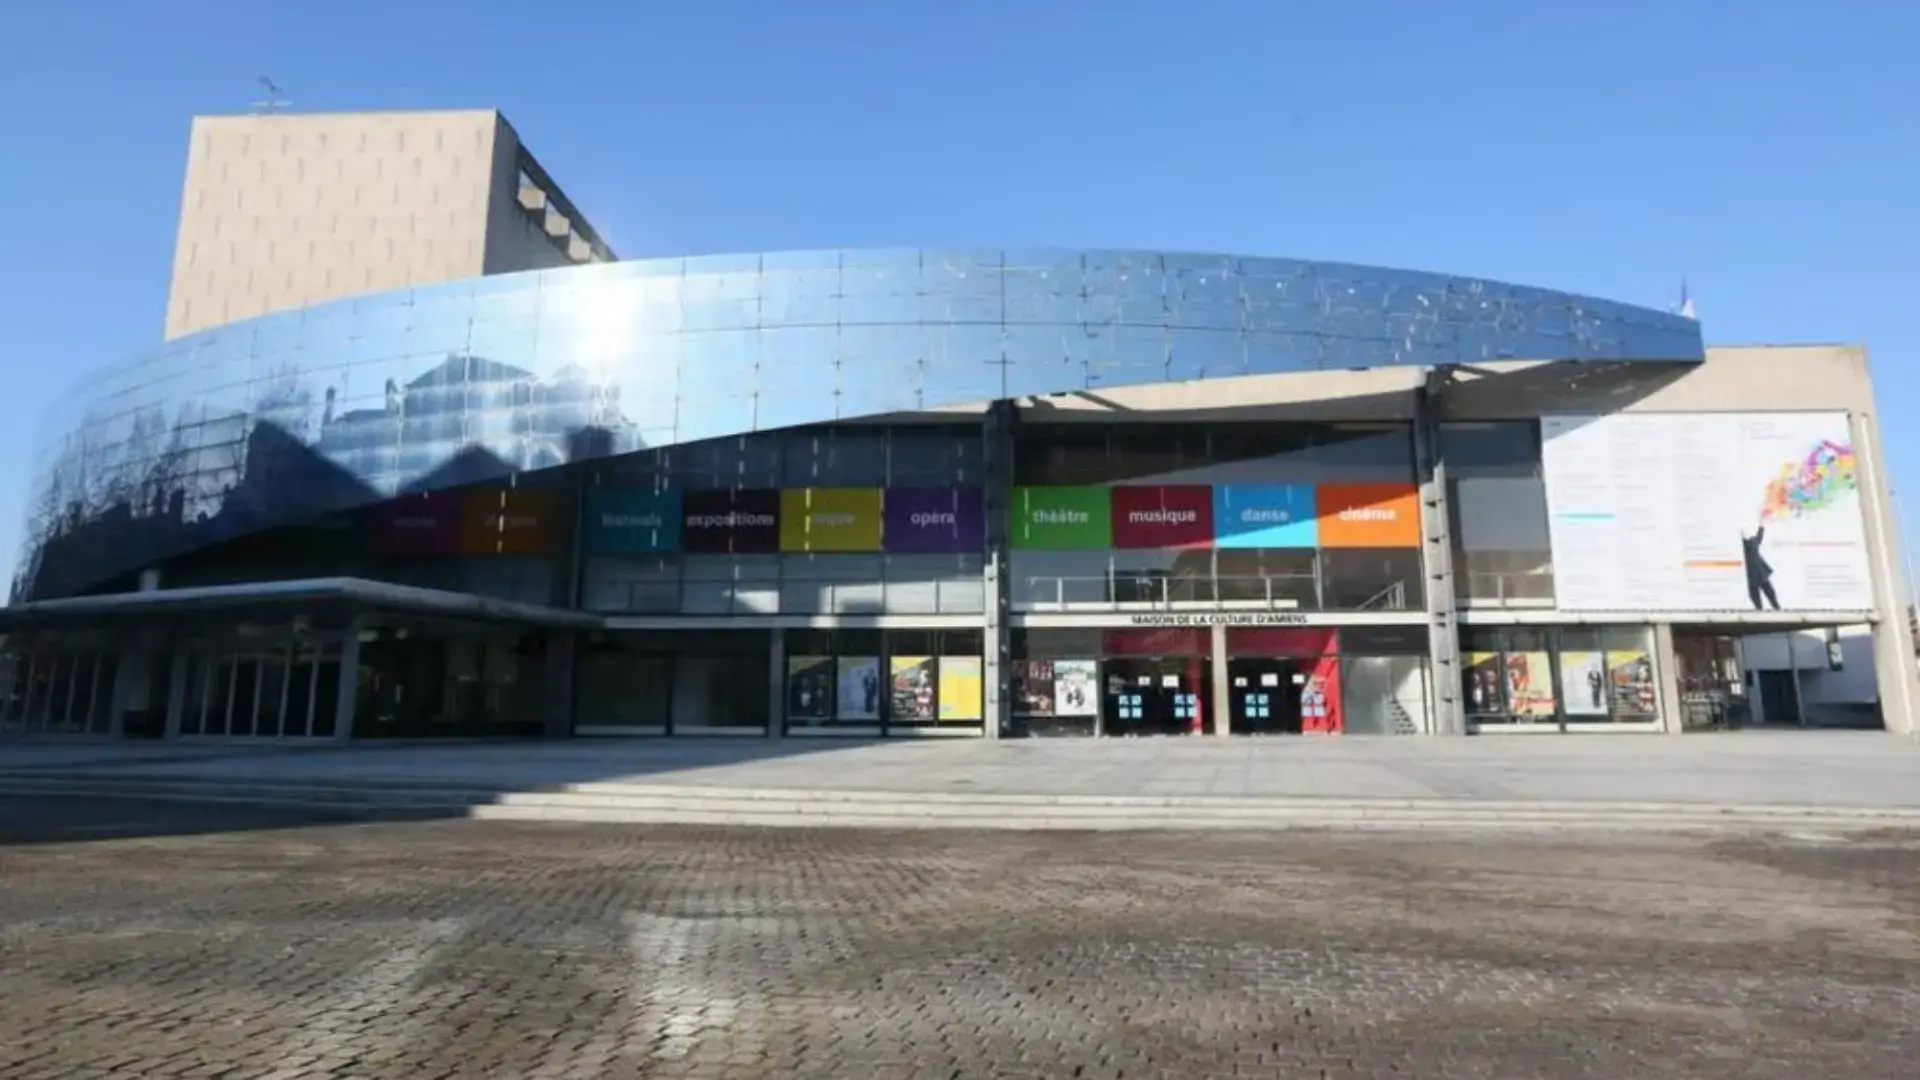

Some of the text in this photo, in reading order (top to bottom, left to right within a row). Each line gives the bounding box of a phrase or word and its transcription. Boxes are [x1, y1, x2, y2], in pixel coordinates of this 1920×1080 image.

[1129, 508, 1196, 525] musique
[1241, 508, 1289, 522] danse
[1132, 614, 1307, 624] MAISON DE LA CULTURE D'AMIENS
